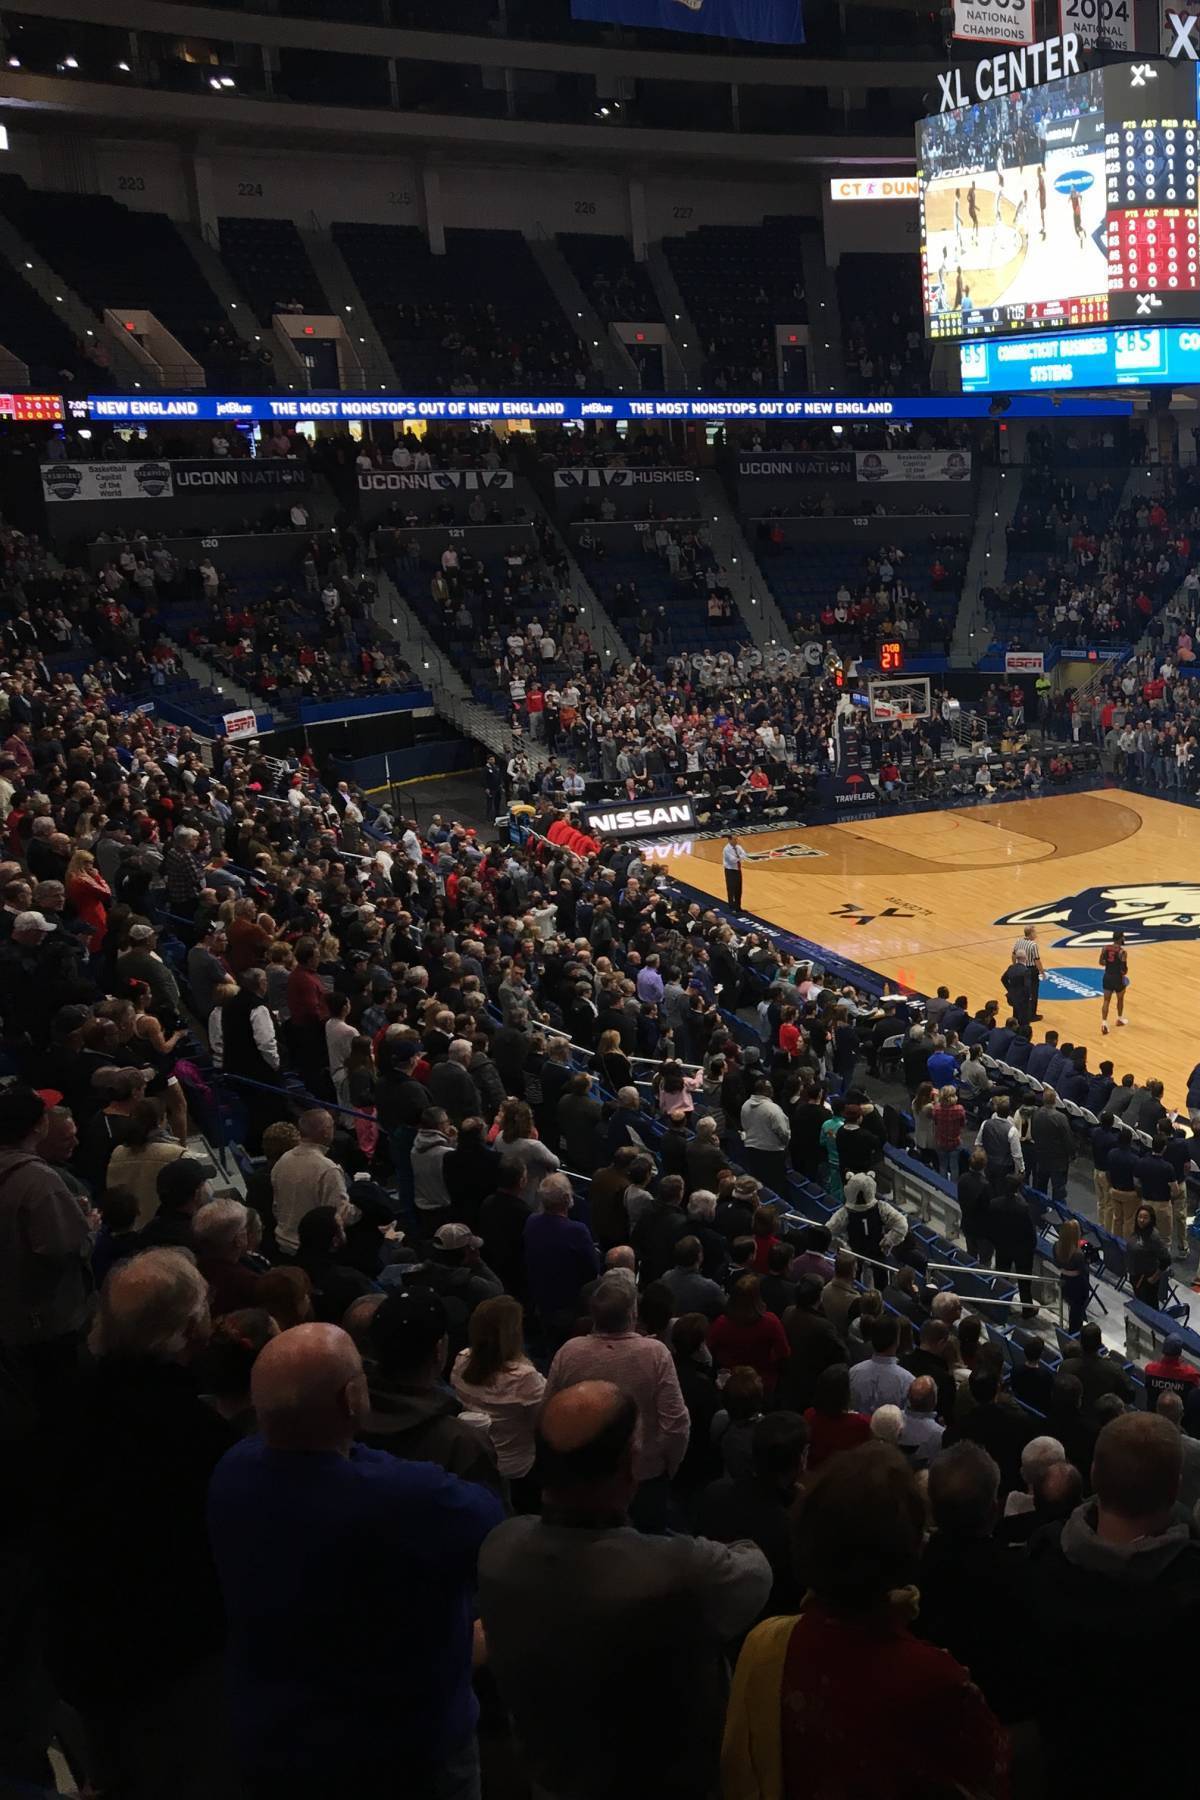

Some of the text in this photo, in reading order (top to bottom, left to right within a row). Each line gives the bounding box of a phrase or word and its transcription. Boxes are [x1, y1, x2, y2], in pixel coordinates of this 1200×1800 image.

[967, 10, 1020, 25] NATIONAL
[963, 23, 1025, 40] CHAMPIONS
[937, 32, 1080, 113] XL CENTER
[1125, 130, 1134, 142] 0
[1145, 129, 1154, 141] 0
[1165, 129, 1175, 141] 0
[1185, 129, 1195, 141] 0
[1125, 145, 1135, 157] 0
[1145, 144, 1154, 156] 0
[1165, 144, 1175, 156] 0
[1186, 144, 1195, 156] 0
[1126, 160, 1135, 172] 0
[1145, 159, 1155, 171] 0
[1167, 158, 1174, 171] 1
[1186, 159, 1195, 171] 0
[931, 164, 985, 180] UCONN
[118, 176, 145, 192] 223
[1126, 175, 1135, 186] 0
[1145, 174, 1155, 185] 0
[1168, 173, 1174, 185] 1
[1186, 174, 1195, 185] 0
[238, 183, 264, 198] 224
[840, 183, 862, 196] CT
[1127, 189, 1136, 201] 0
[1146, 188, 1155, 200] 0
[1166, 188, 1176, 200] 0
[1186, 188, 1195, 200] 0
[574, 201, 596, 215] 226
[1128, 220, 1136, 231] 2
[1147, 218, 1156, 230] 0
[1168, 218, 1175, 229] 1
[1187, 218, 1196, 230] 0
[1128, 234, 1137, 246] 0
[1147, 233, 1156, 245] 0
[1169, 233, 1175, 244] 1
[1187, 233, 1196, 244] 0
[992, 308, 1000, 321] 0
[1006, 304, 1025, 320] 17:09
[1031, 305, 1038, 318] 2
[998, 337, 1108, 361] CONNECTICUT BUSINESS
[1030, 364, 1073, 382] SYSTEMS
[96, 401, 198, 415] NEW ENGLAND
[216, 402, 252, 416] jetBlue
[270, 401, 564, 415] THE MOST NONSTOPS OUT OF NEW ENGLAND
[581, 402, 613, 415] jetBlue
[629, 402, 893, 414] THE MOST NONSTOPS OUT OF NEW ENGLAND
[88, 465, 127, 473] Basketball
[739, 462, 793, 475] UCONN
[95, 473, 122, 482] Capital
[176, 471, 238, 486] UCONN
[358, 474, 431, 490] UCONN
[633, 470, 694, 484] HUSKIES
[100, 489, 122, 497] World
[852, 518, 868, 526] 123
[448, 529, 465, 538] 121
[200, 538, 219, 548] 120
[882, 653, 900, 670] 21
[1007, 657, 1043, 669] ESPN
[227, 715, 256, 733] ESPN
[835, 792, 876, 803] TRAVELERS
[588, 805, 691, 831] NISSAN
[1108, 952, 1115, 962] 5
[1152, 1379, 1184, 1390] UCONN
